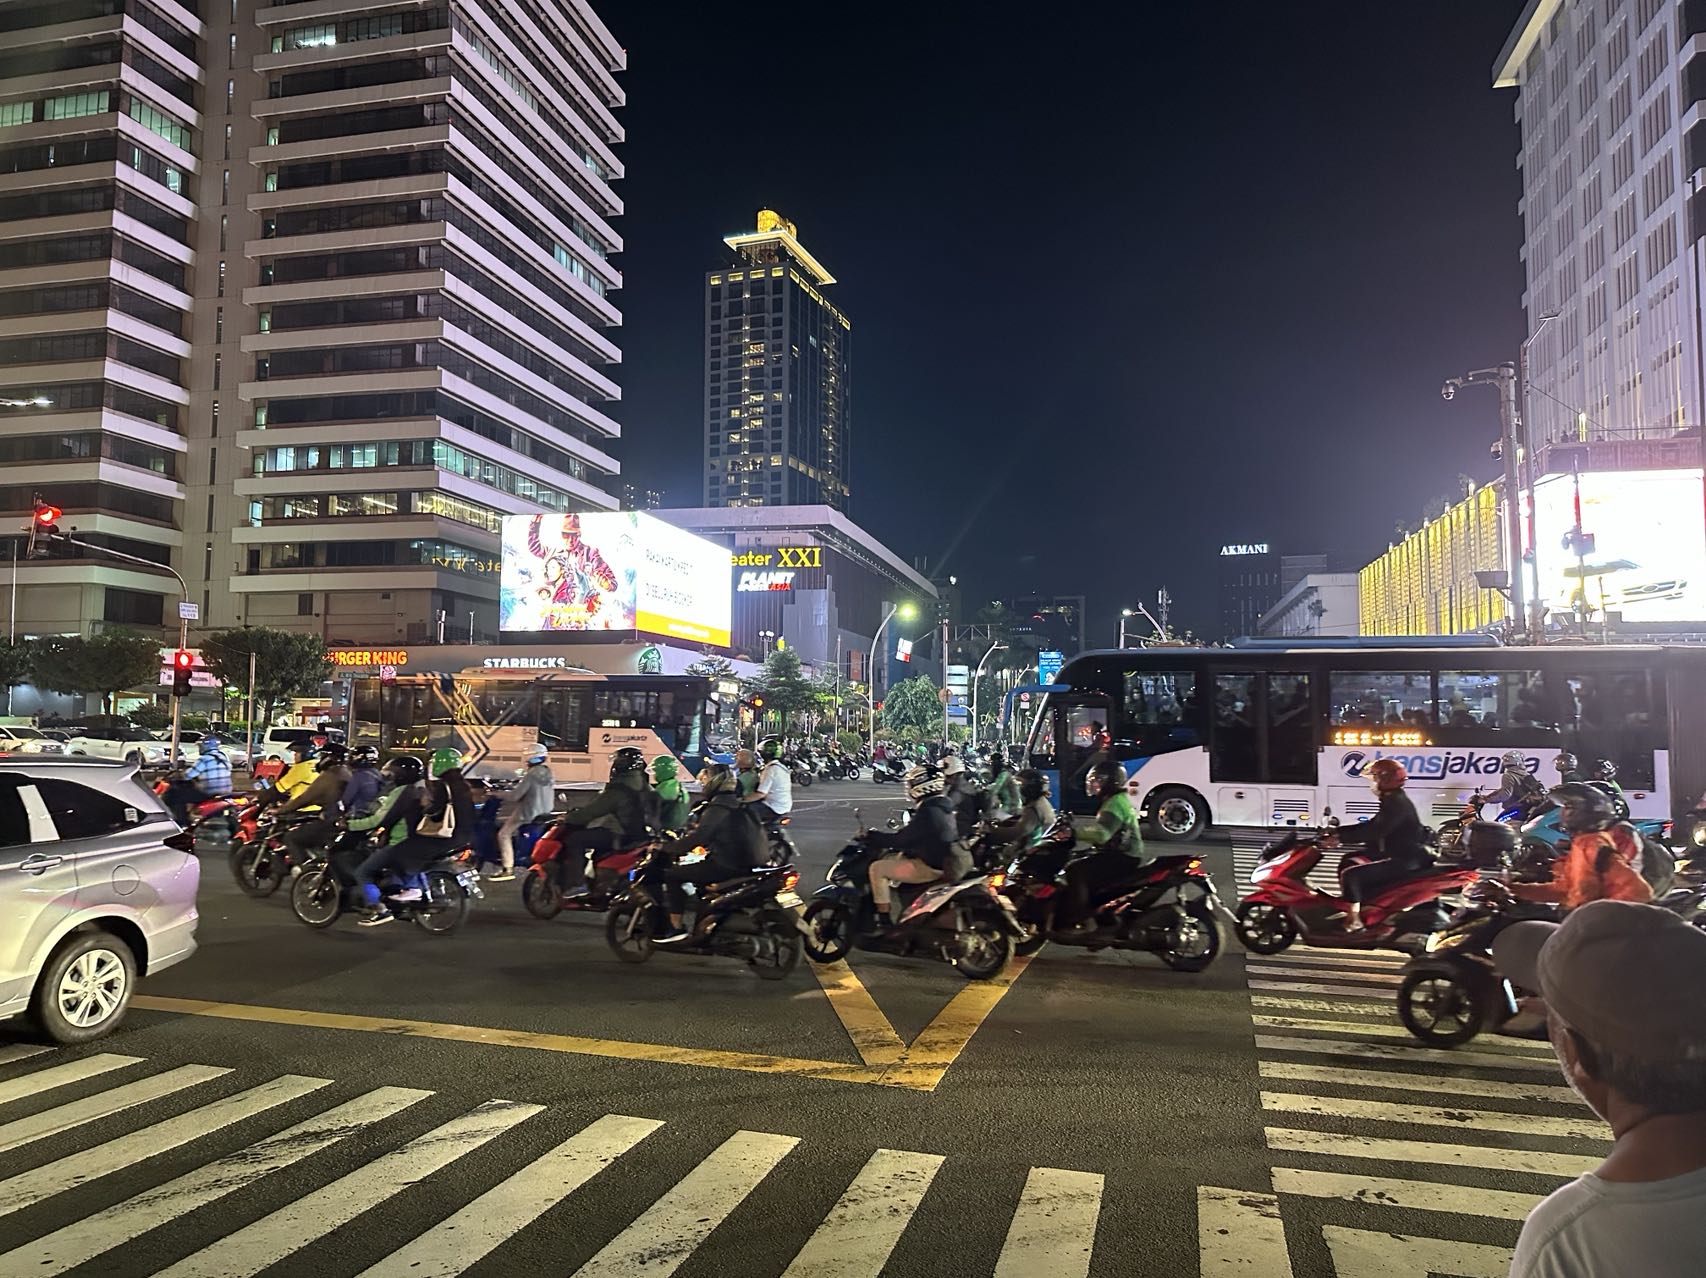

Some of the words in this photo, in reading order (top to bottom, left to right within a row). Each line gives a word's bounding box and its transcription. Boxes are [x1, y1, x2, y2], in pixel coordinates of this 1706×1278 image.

[1220, 543, 1268, 556] AKMANI
[777, 547, 821, 567] XXI
[372, 651, 407, 665] KING
[483, 657, 566, 669] STARBUCKS
